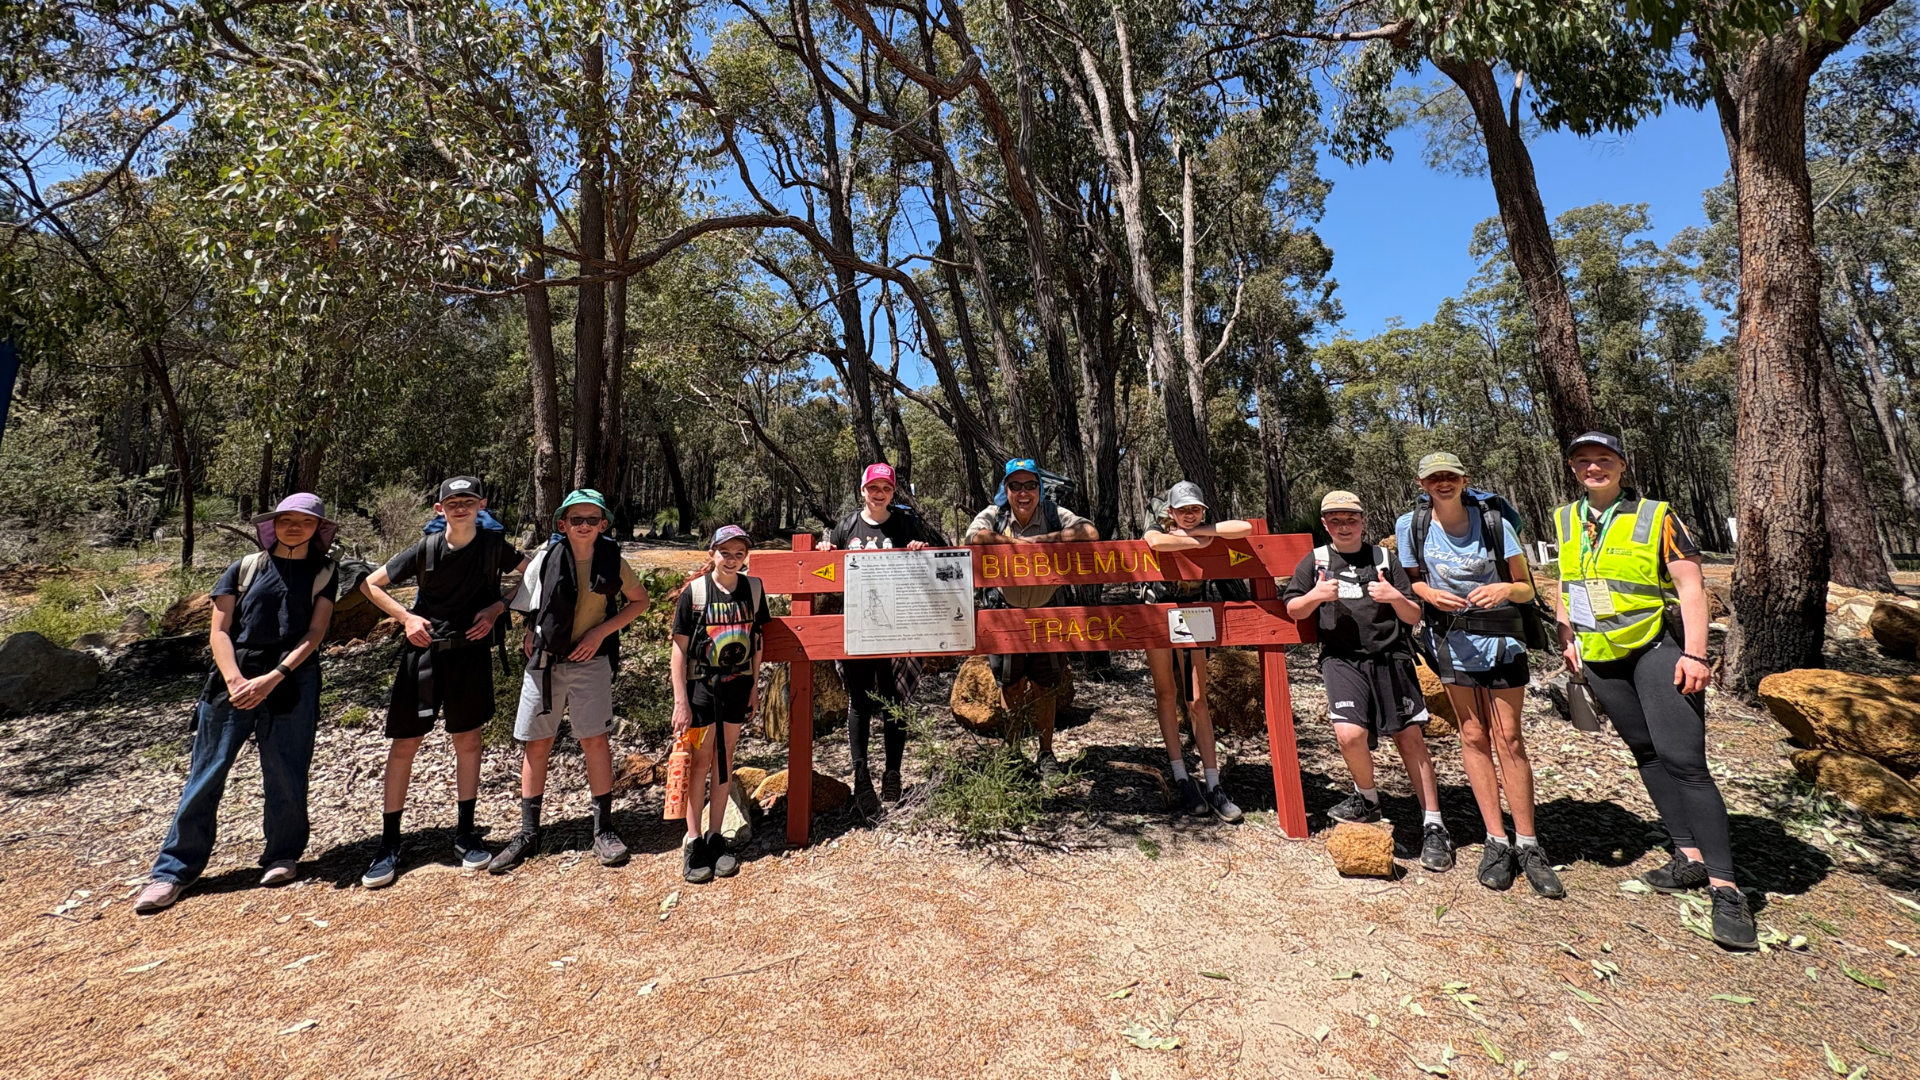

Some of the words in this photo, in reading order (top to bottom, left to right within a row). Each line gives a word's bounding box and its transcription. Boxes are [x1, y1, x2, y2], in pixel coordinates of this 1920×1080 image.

[982, 550, 1161, 579] BIBBULMUN
[705, 600, 754, 624] NIRVAN
[1024, 615, 1127, 643] TRACK
